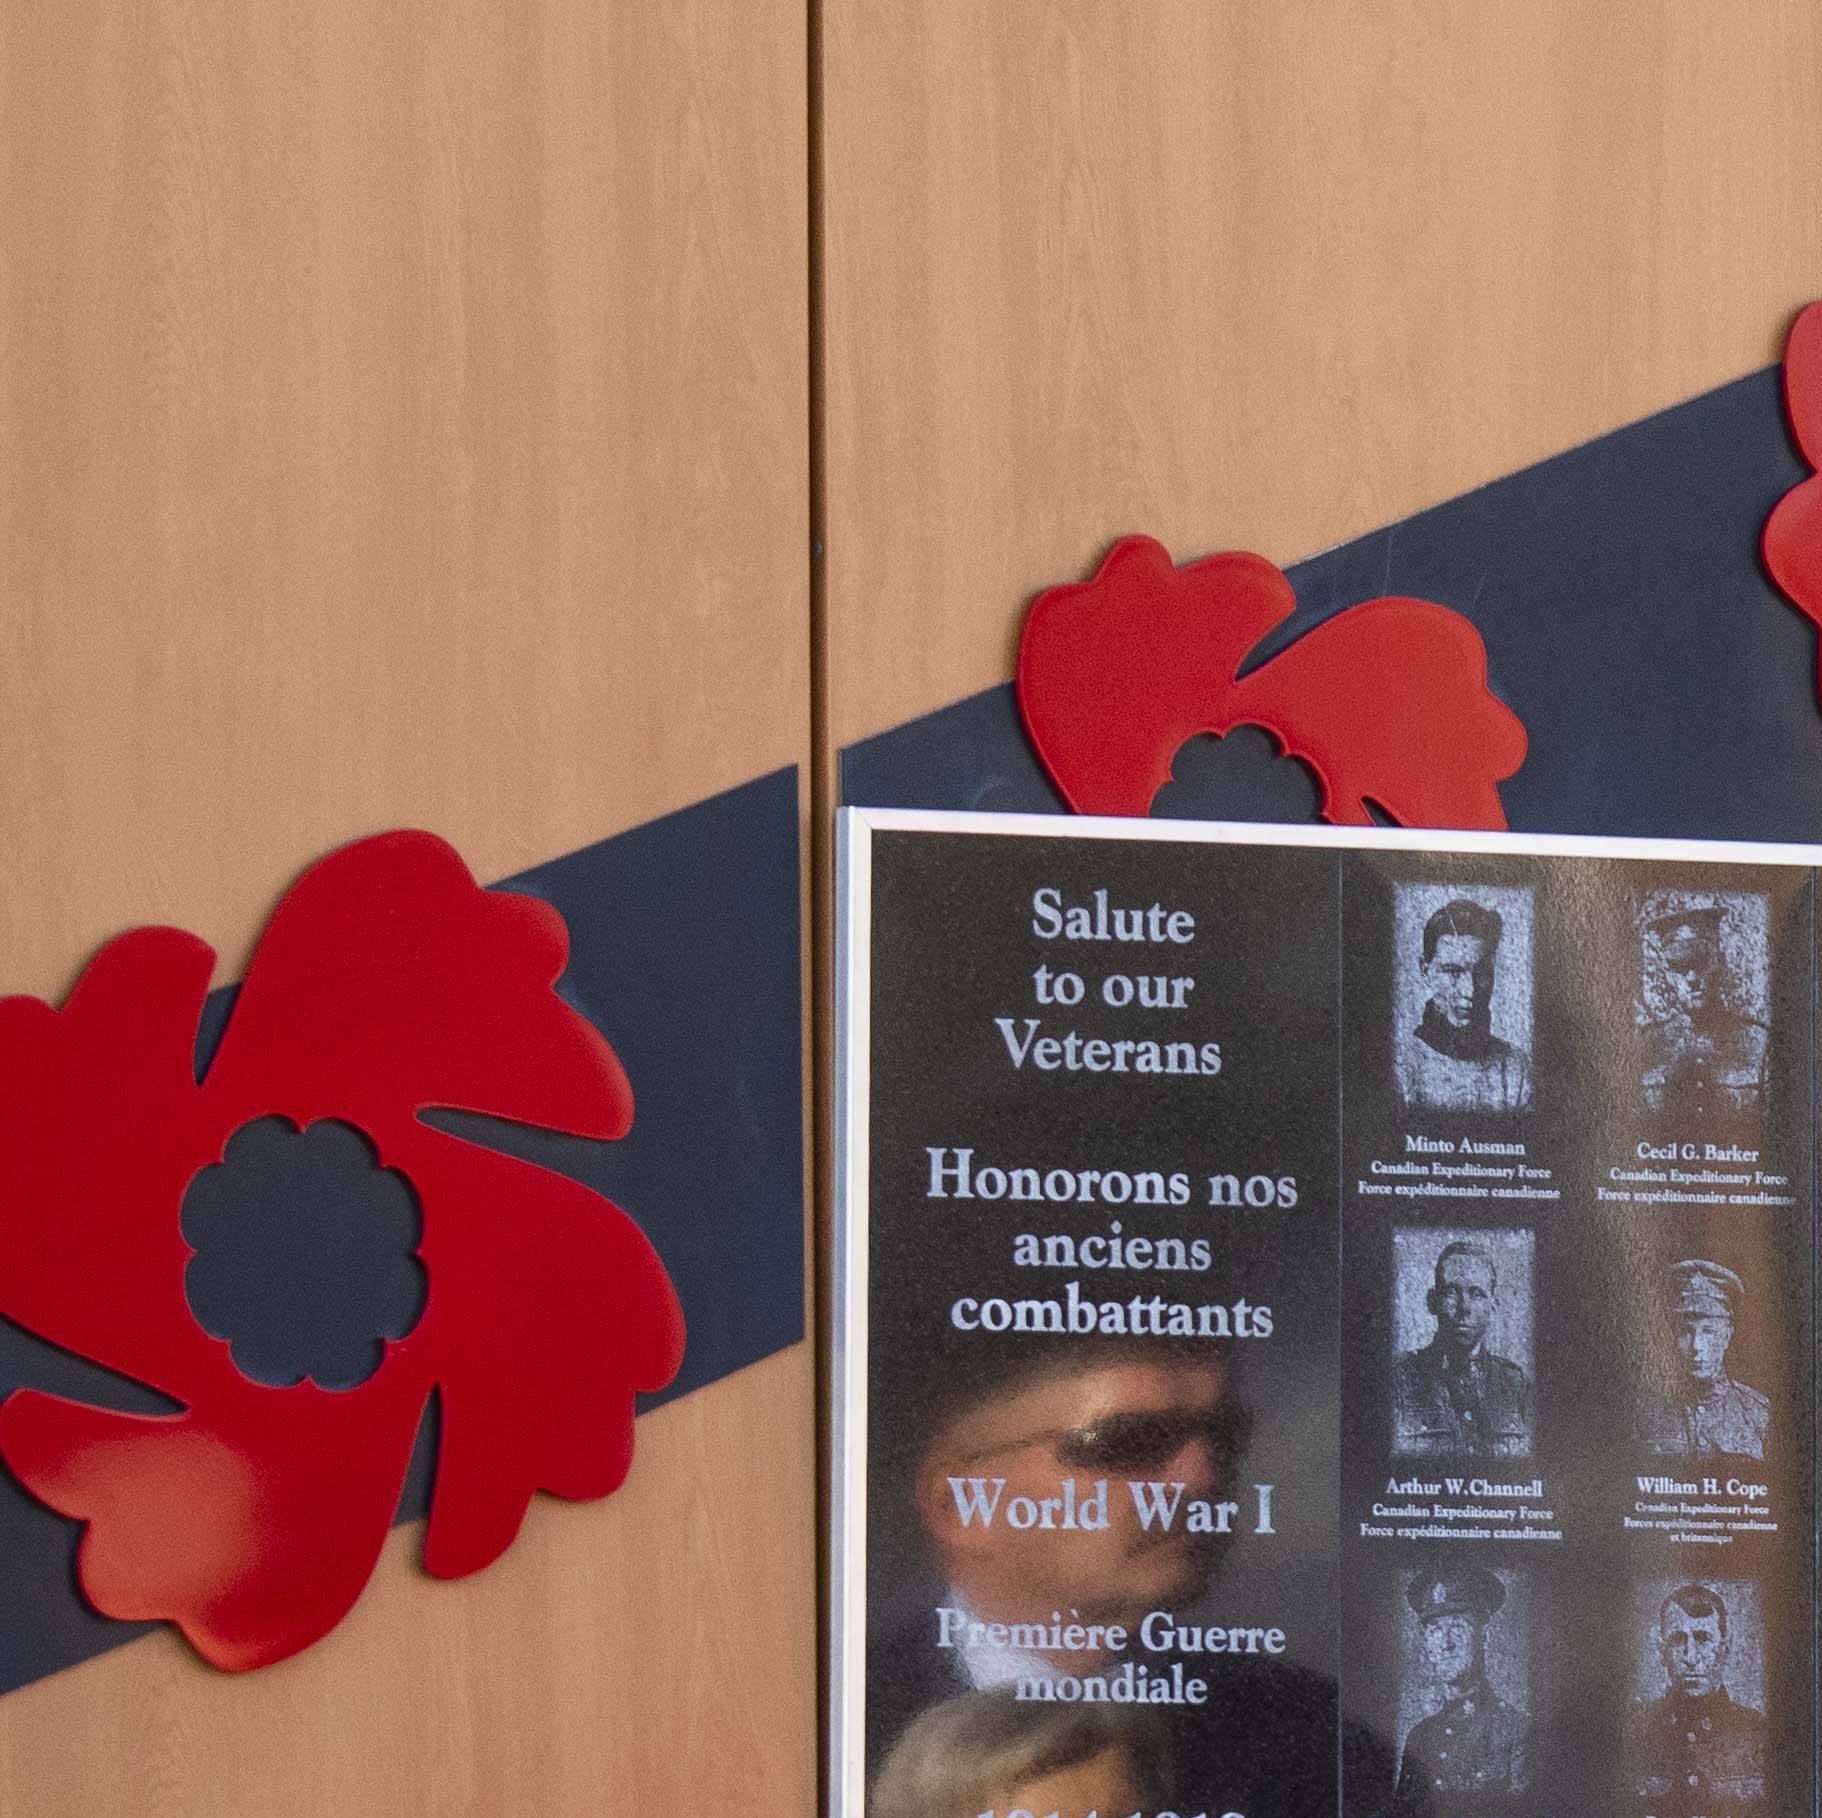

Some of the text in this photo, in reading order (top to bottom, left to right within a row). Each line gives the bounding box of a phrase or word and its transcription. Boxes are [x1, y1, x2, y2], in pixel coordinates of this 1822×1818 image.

[1032, 887, 1194, 943] Salute
[1032, 964, 1195, 1008] to our
[994, 1017, 1221, 1075] Veterans
[1405, 1134, 1525, 1155] Minto Ausman
[1636, 1141, 1759, 1162] Cecil G. Barker
[925, 1147, 1297, 1208] Honorons nos
[1013, 1220, 1211, 1271] anciens
[951, 1281, 1273, 1337] combattants
[946, 1477, 1275, 1533] World War I
[1636, 1476, 1767, 1500] William H. Cope
[935, 1601, 1285, 1653] Première Guerre
[1014, 1661, 1207, 1704] mondiale
